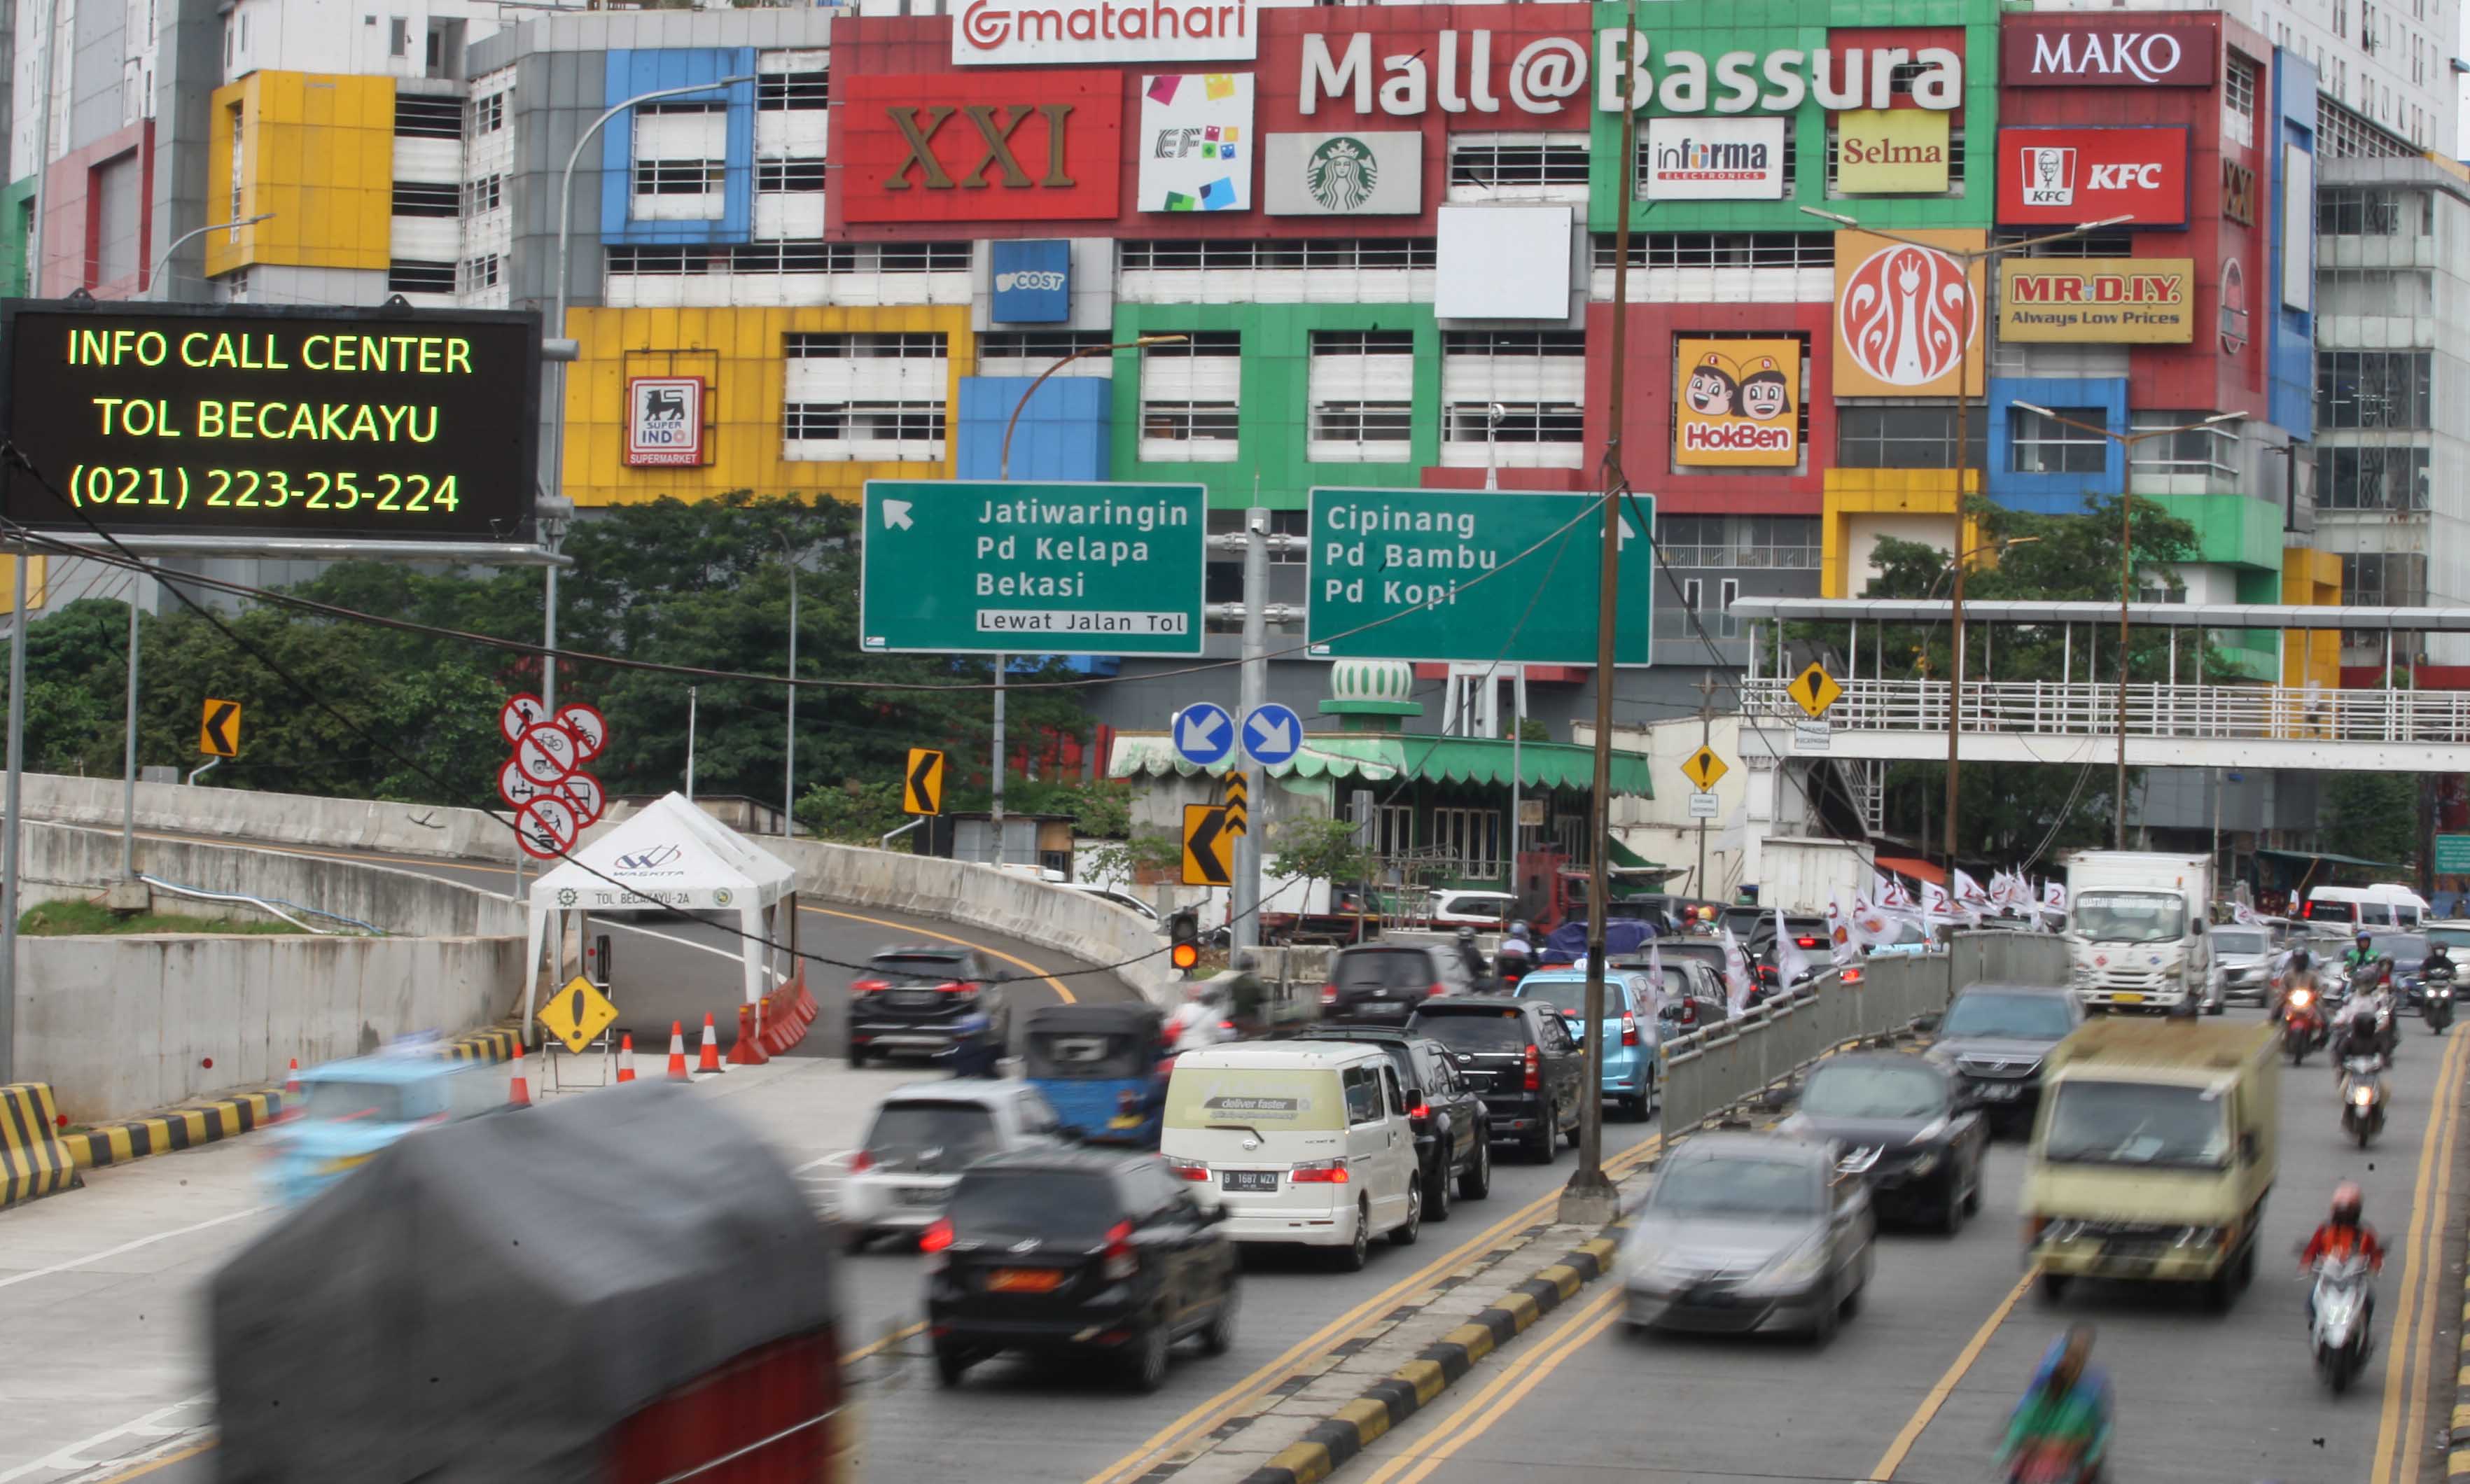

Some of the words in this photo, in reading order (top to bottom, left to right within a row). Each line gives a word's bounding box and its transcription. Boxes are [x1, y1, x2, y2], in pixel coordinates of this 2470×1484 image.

[1017, 0, 1246, 41] matahari
[2030, 33, 2181, 83] MAKO
[884, 104, 1075, 189] XXI
[1657, 138, 1768, 169] informa
[1843, 138, 1943, 164] Selma
[2087, 163, 2162, 190] KFC
[2031, 190, 2065, 202] KFC
[2011, 311, 2078, 327] Always
[2082, 312, 2119, 324] Low
[2123, 312, 2179, 325] Prices
[67, 329, 168, 367] INFO
[181, 332, 288, 370] CALL
[302, 335, 473, 374] CENTER
[92, 398, 181, 438] TOL
[197, 400, 439, 442] BECAKAYU
[646, 421, 682, 430] SUPER
[642, 430, 685, 443] INDO
[1687, 423, 1790, 449] HokBen
[630, 453, 697, 463] SUPERMARKET
[69, 463, 191, 510] (021)
[205, 469, 460, 513] 223-25-224
[979, 498, 1188, 532] Jatiwaringin
[1327, 503, 1475, 539] Cipinang
[977, 536, 1016, 560] Pd
[1035, 536, 1149, 568] Kelapa
[1326, 541, 1365, 566] Pd
[1385, 543, 1496, 570] Bambu
[977, 571, 1084, 597] Bekasi
[1325, 578, 1363, 603] Pd
[1383, 579, 1456, 610] Kopi
[980, 612, 1052, 630] Lewat
[1066, 613, 1131, 631] Jalan
[1147, 614, 1183, 631] Tol
[596, 892, 615, 904] TOL
[1884, 881, 1898, 905] 2
[1933, 890, 1947, 912] 2
[2050, 889, 2061, 906] 2
[1222, 1098, 1256, 1109] deliver
[1258, 1098, 1288, 1110] faster
